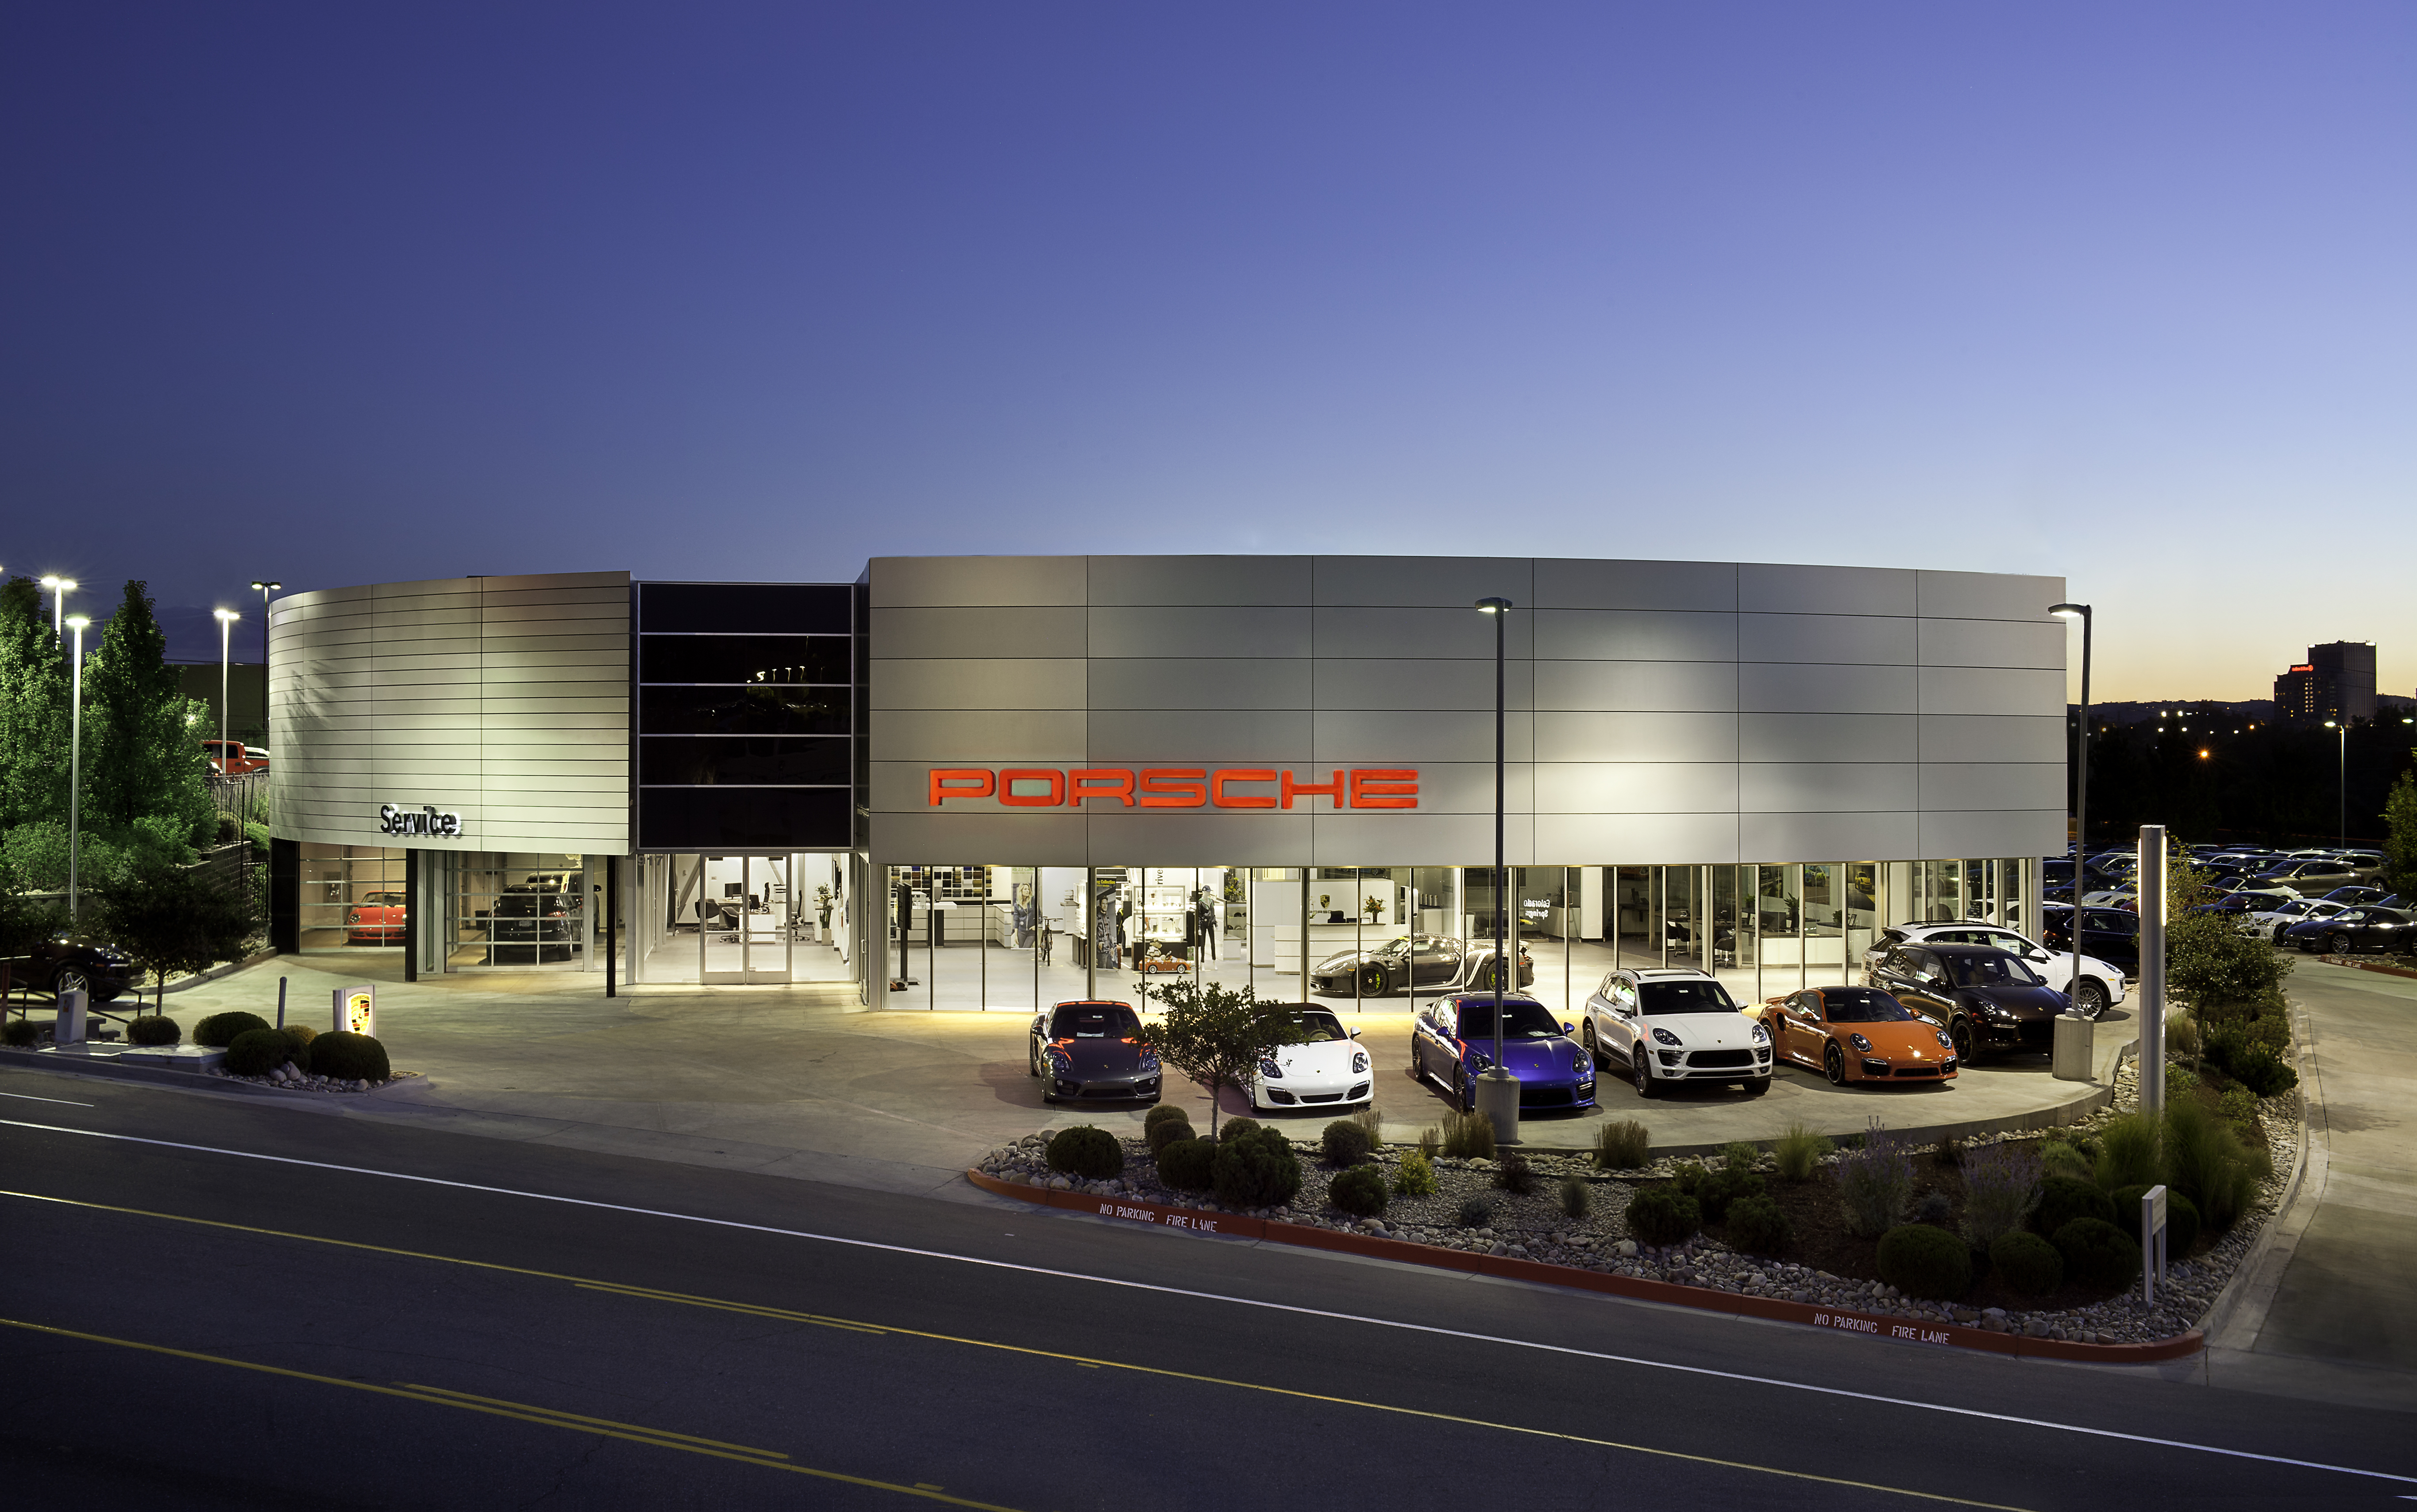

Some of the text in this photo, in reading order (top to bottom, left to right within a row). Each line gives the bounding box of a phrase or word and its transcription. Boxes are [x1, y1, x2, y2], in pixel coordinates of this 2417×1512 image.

[929, 769, 1418, 809] PORSCHE
[380, 805, 456, 834] Service
[638, 855, 663, 866] 917
[1100, 1203, 1112, 1215] NO
[1116, 1206, 1154, 1222] PARKING
[1166, 1215, 1188, 1227] FIRE
[1814, 1313, 1950, 1344] NO PARKING FIRE LANE
